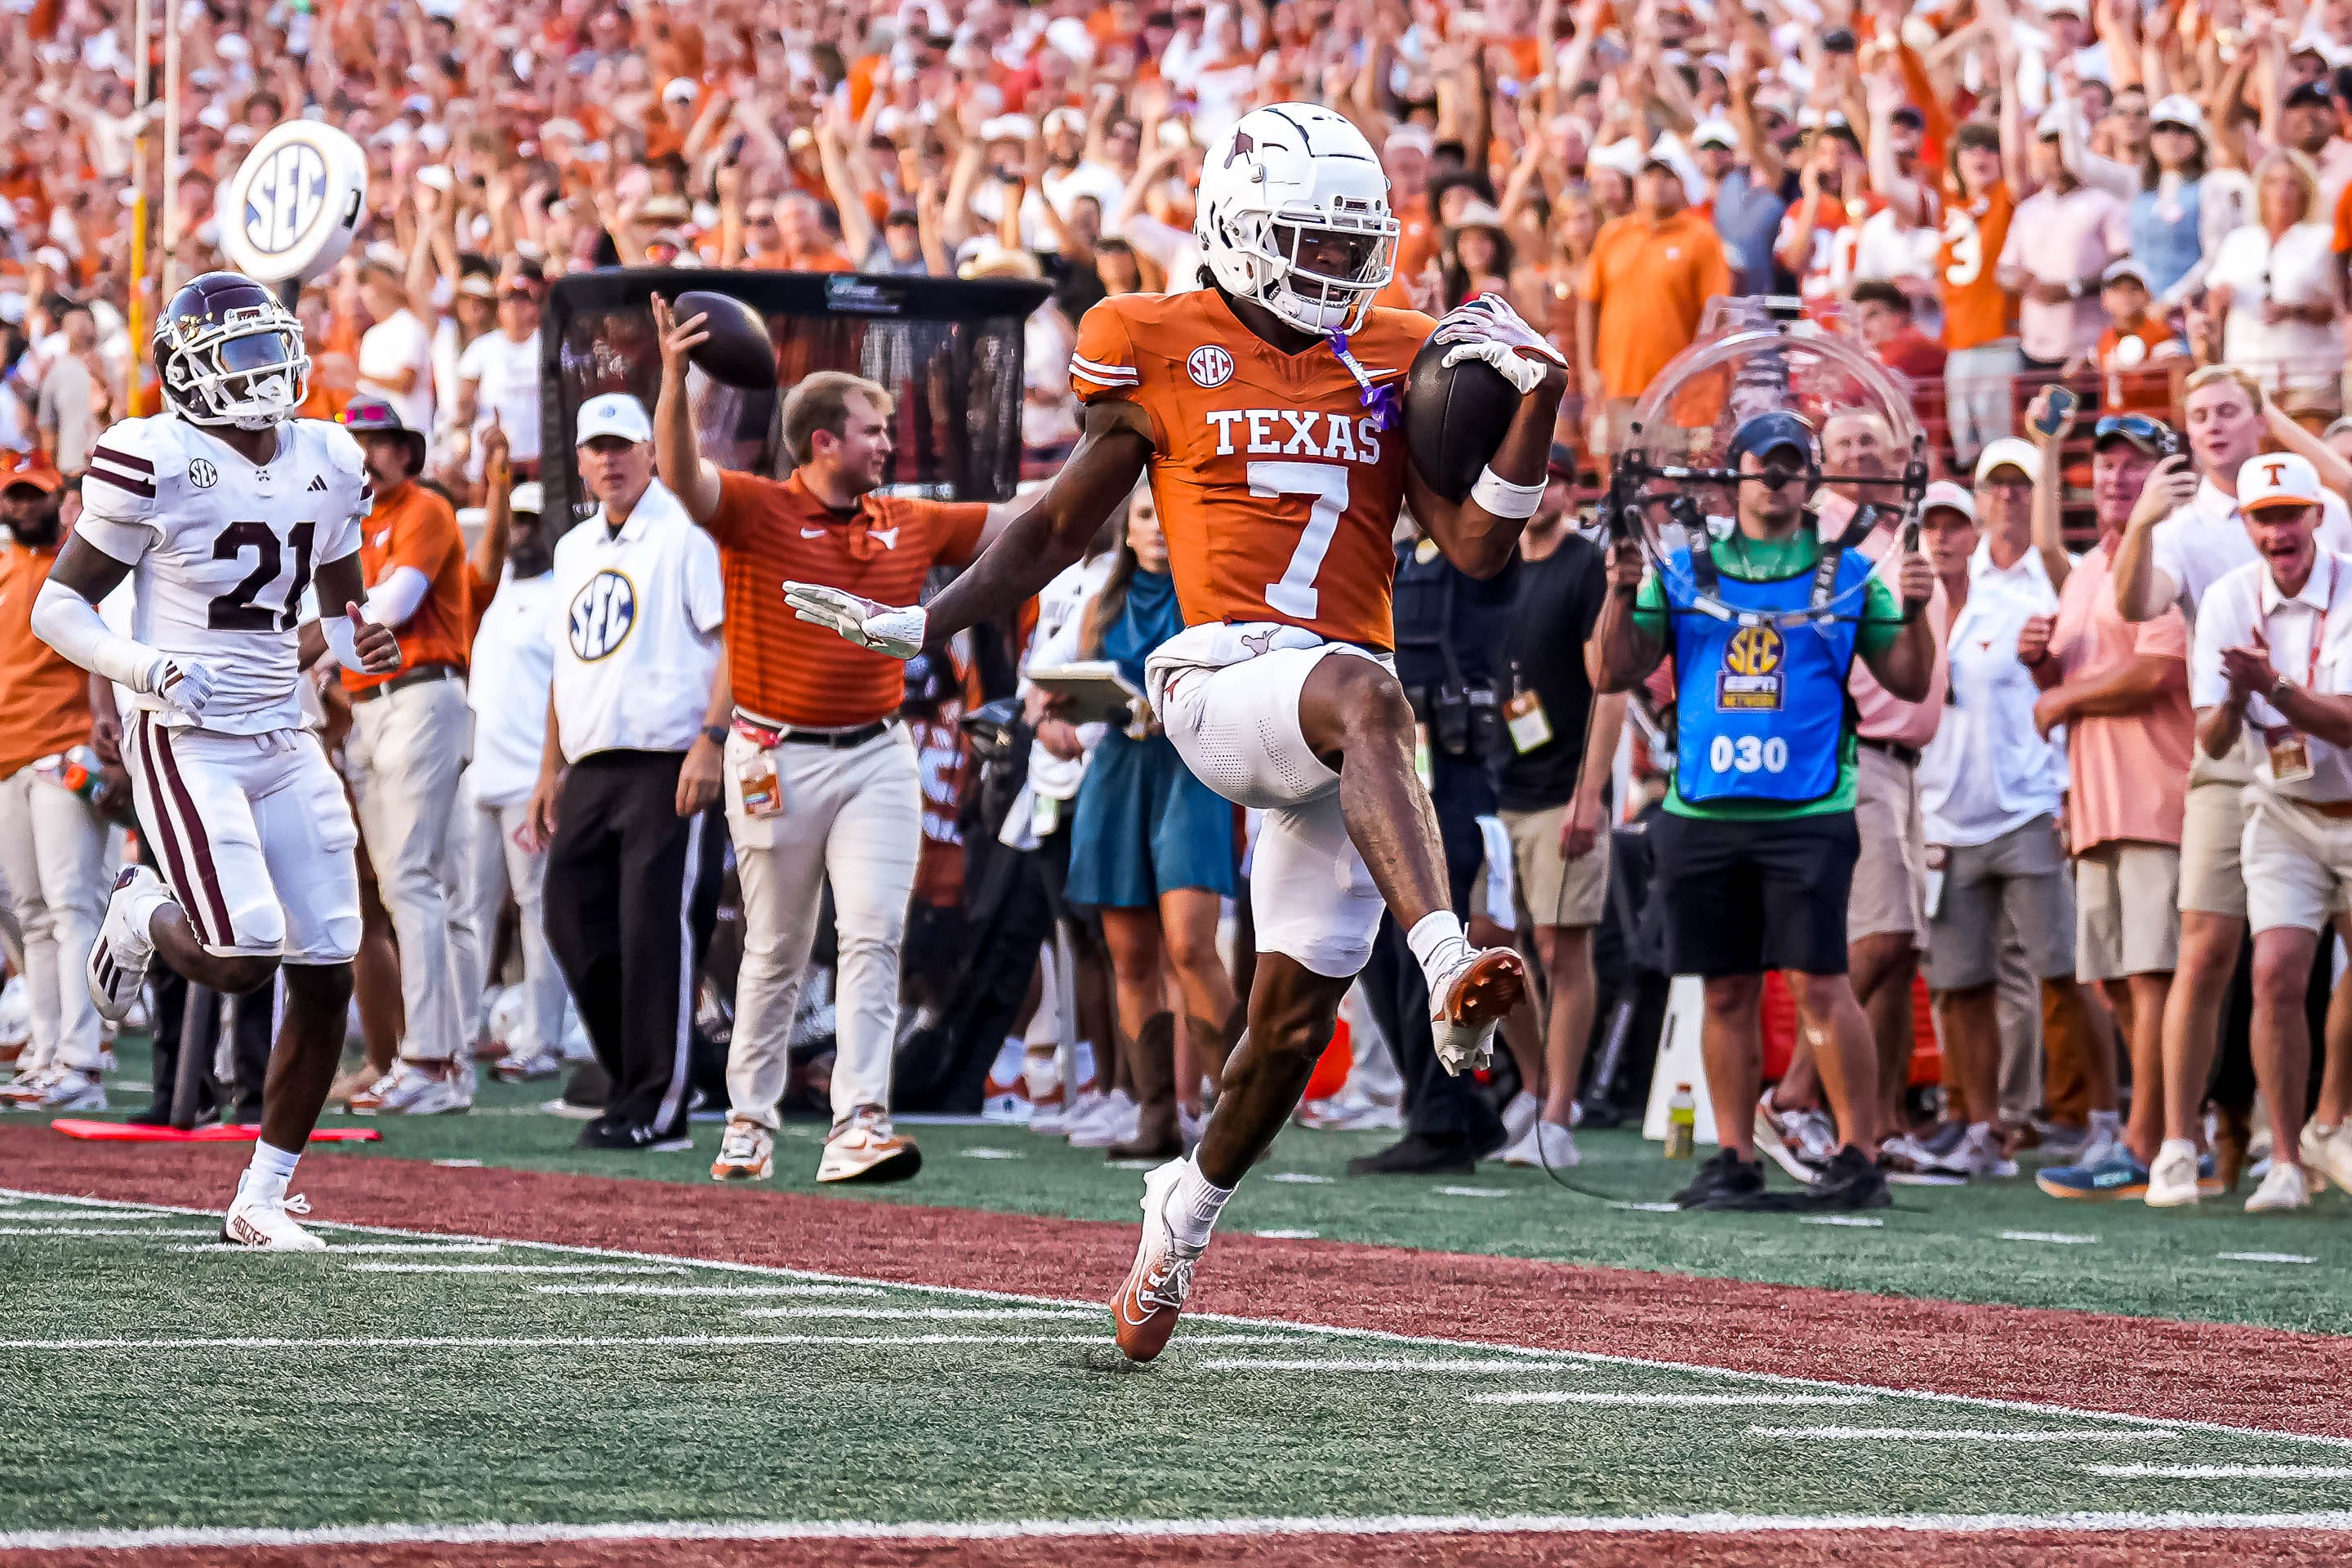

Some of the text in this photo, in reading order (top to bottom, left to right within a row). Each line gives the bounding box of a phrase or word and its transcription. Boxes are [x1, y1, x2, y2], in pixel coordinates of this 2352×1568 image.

[245, 145, 325, 252] SEC
[1190, 348, 1230, 385] SEC
[1205, 409, 1382, 465] TEXAS
[189, 459, 217, 488] SEC
[2263, 464, 2286, 485] T
[1246, 461, 1349, 620] 7
[207, 521, 317, 632] 21
[571, 572, 634, 659] SEC
[1726, 626, 1780, 675] SEC
[1709, 736, 1788, 773] 030
